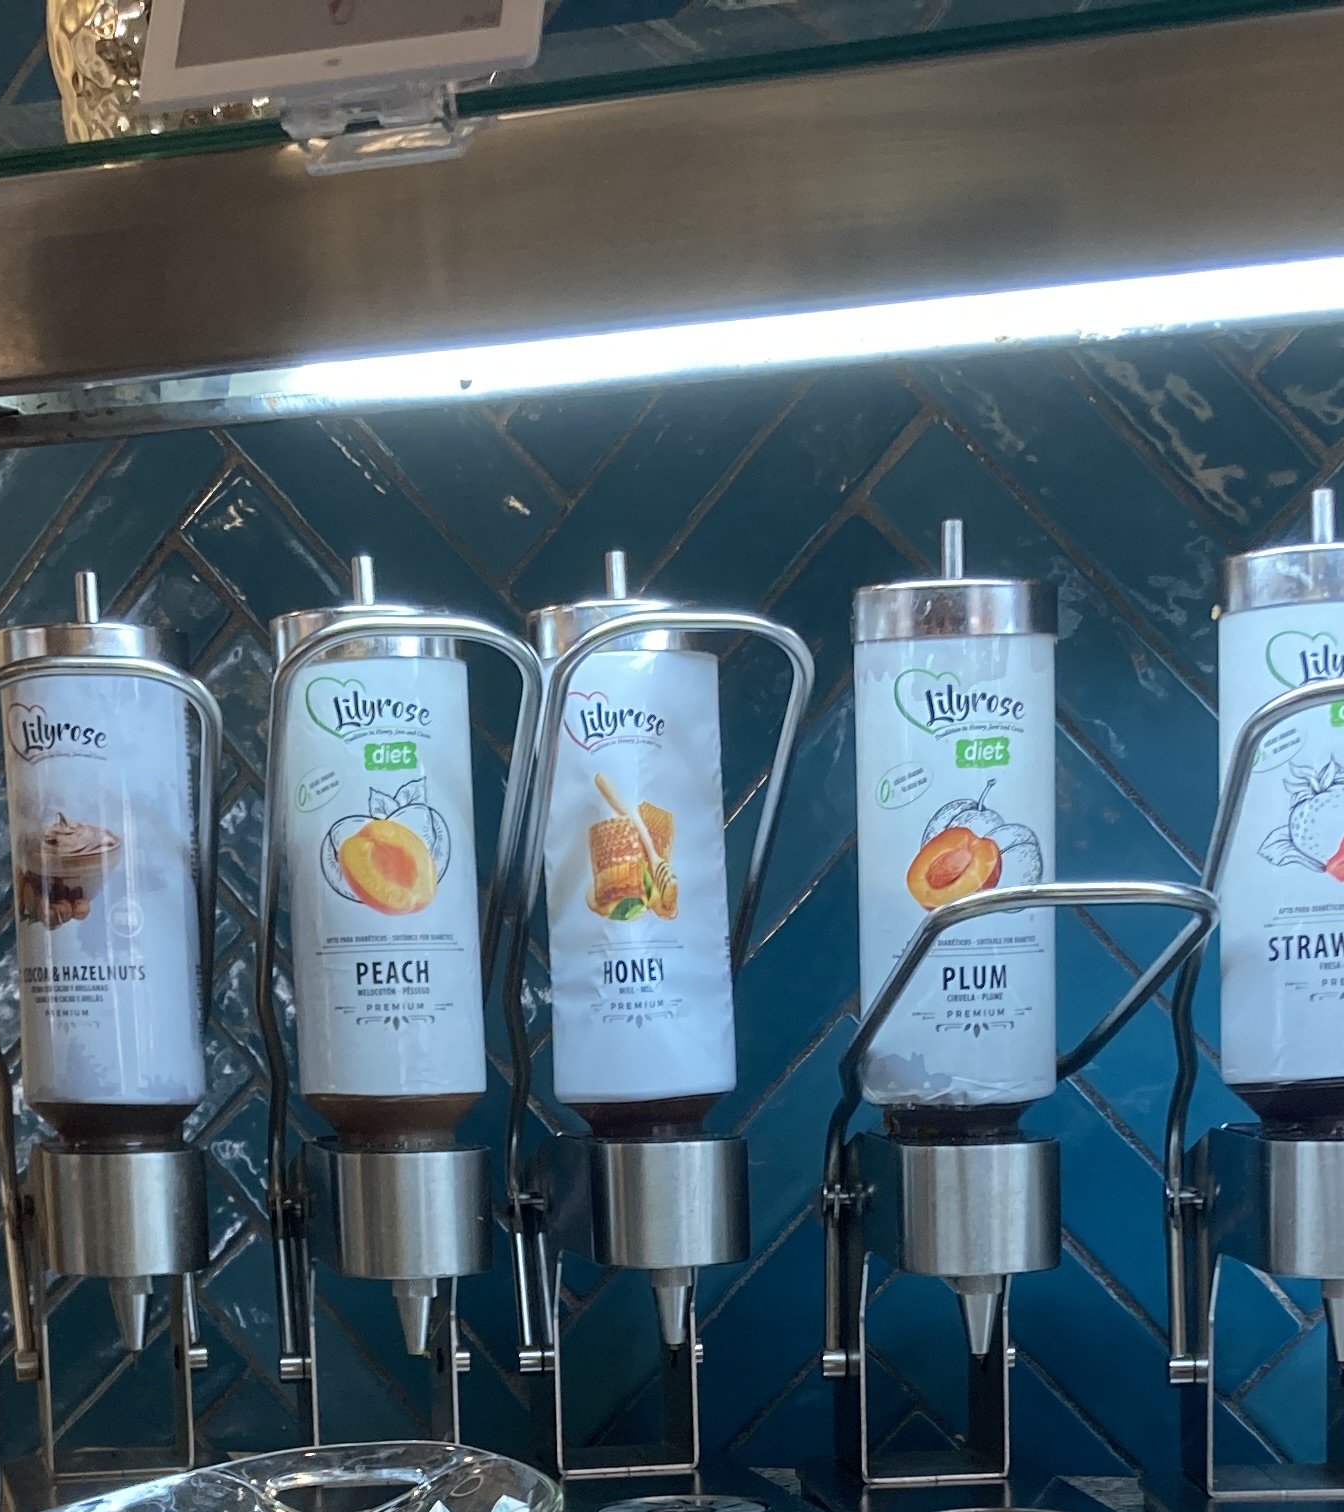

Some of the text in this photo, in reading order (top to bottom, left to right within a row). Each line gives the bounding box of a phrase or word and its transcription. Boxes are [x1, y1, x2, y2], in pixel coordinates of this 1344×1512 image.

[333, 690, 432, 731] Lilyrose
[925, 684, 1026, 727] Lilyrose
[22, 714, 108, 755] Lilyrose
[580, 702, 665, 744] Lilyrose
[372, 744, 412, 765] diet
[964, 741, 1005, 762] diet
[62, 965, 146, 981] HAZELNUTS
[356, 960, 429, 985] PEACH
[603, 958, 664, 984] HONEY
[942, 964, 1007, 991] PLUM
[366, 1002, 424, 1012] PREMIUM
[610, 999, 664, 1010] PREMIUM
[946, 1008, 1005, 1018] PREMIUM
